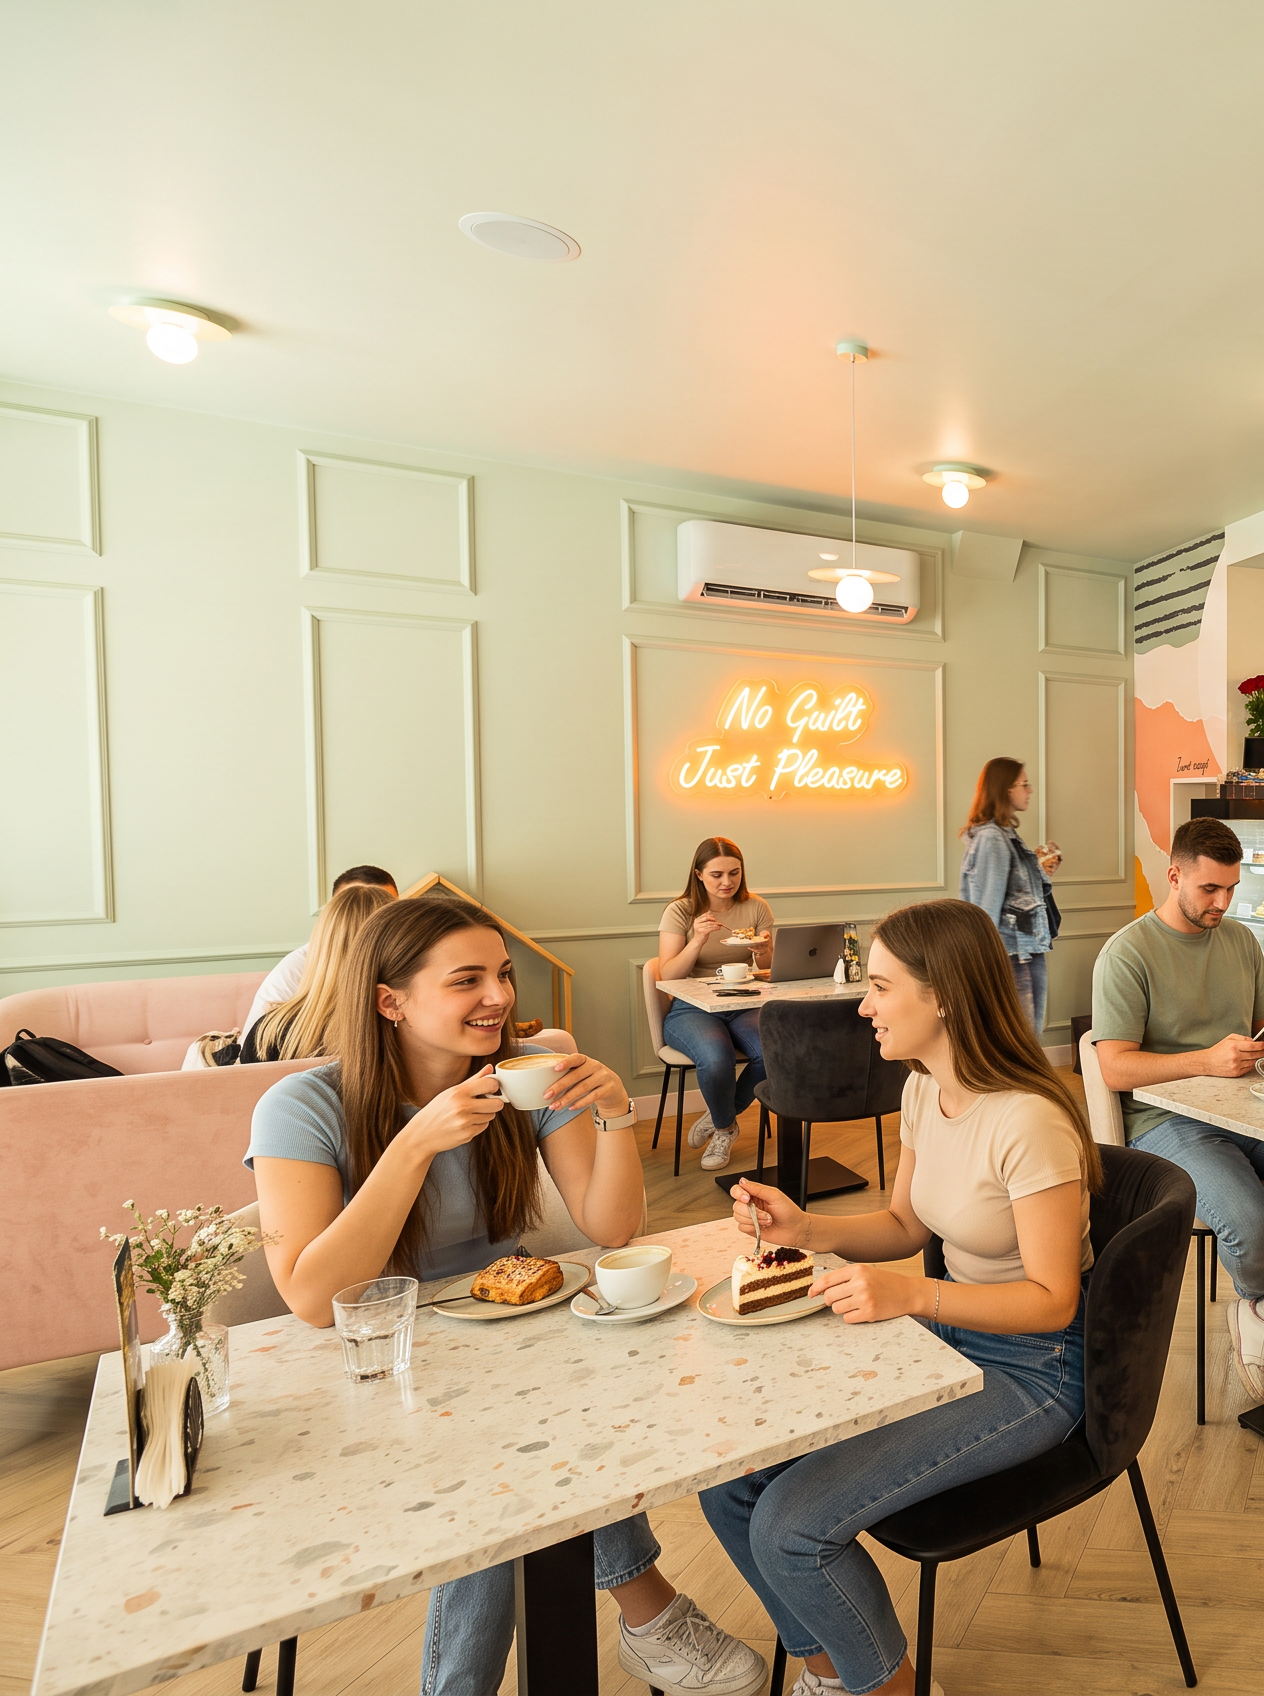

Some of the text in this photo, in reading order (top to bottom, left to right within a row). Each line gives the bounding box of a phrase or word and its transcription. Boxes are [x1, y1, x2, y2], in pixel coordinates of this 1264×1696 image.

[724, 686, 867, 743] No Guilt
[679, 745, 903, 791] Just Pleasure
